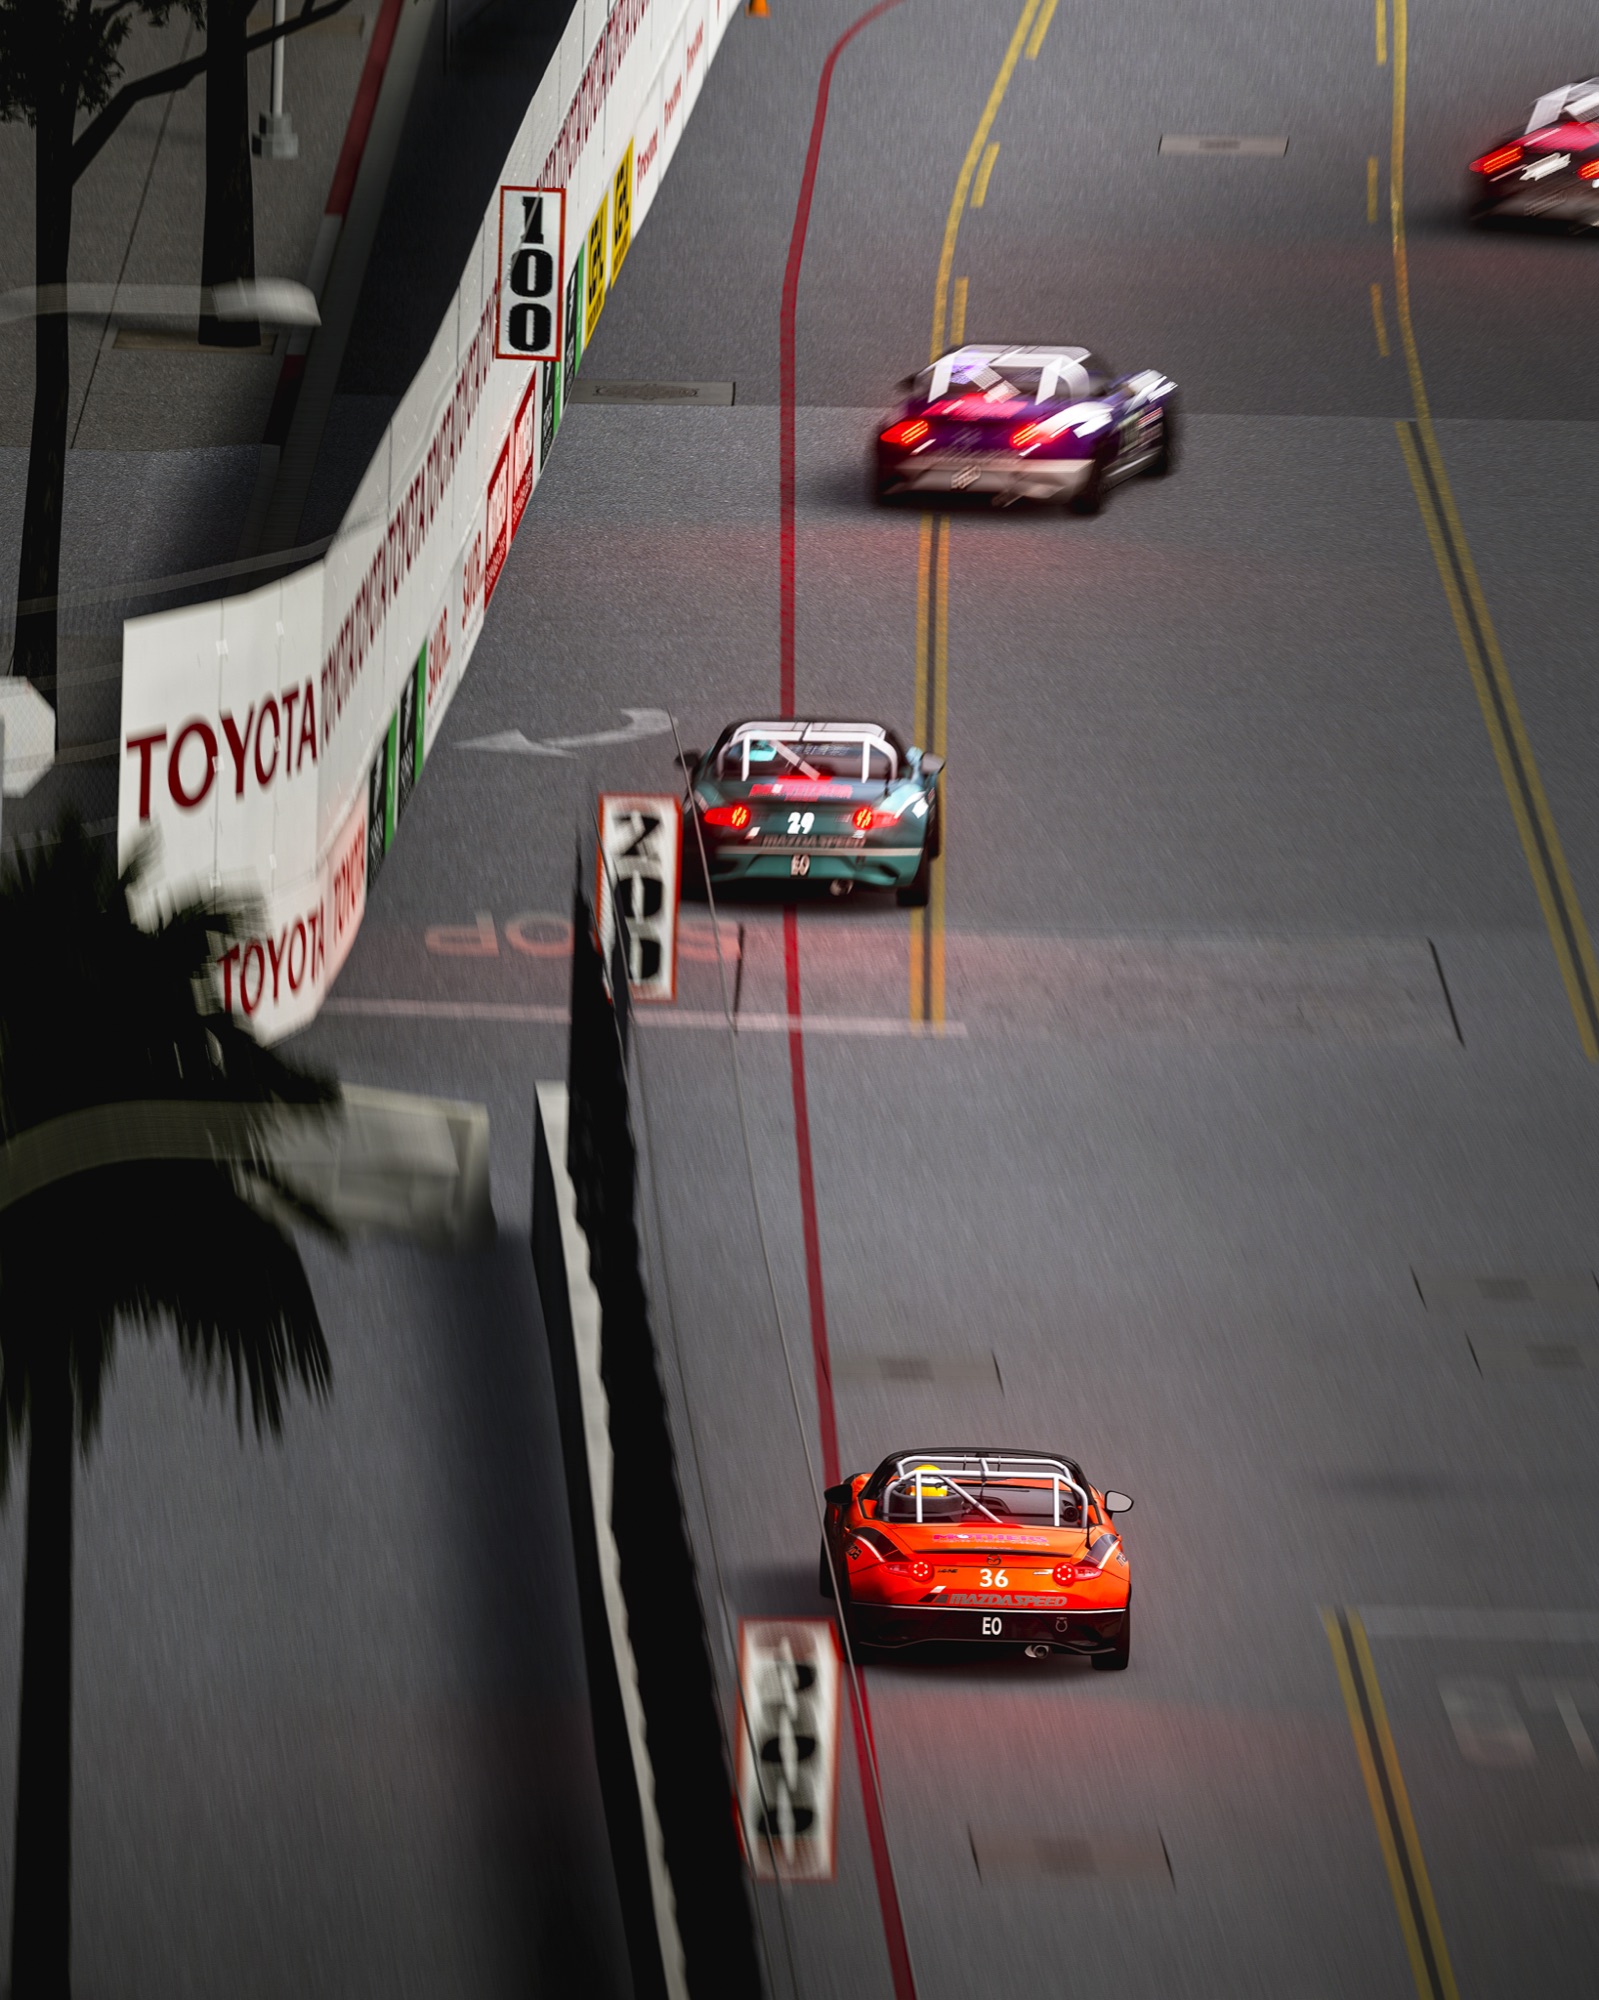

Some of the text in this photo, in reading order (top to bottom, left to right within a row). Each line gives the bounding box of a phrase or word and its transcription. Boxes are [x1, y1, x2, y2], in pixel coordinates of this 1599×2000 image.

[508, 196, 554, 352] 100
[126, 675, 318, 827] TOYOTA
[787, 811, 815, 835] 29
[217, 898, 325, 1018] TOYOTA
[949, 1593, 1067, 1607] MAZDASPEED
[979, 1568, 1009, 1588] 36
